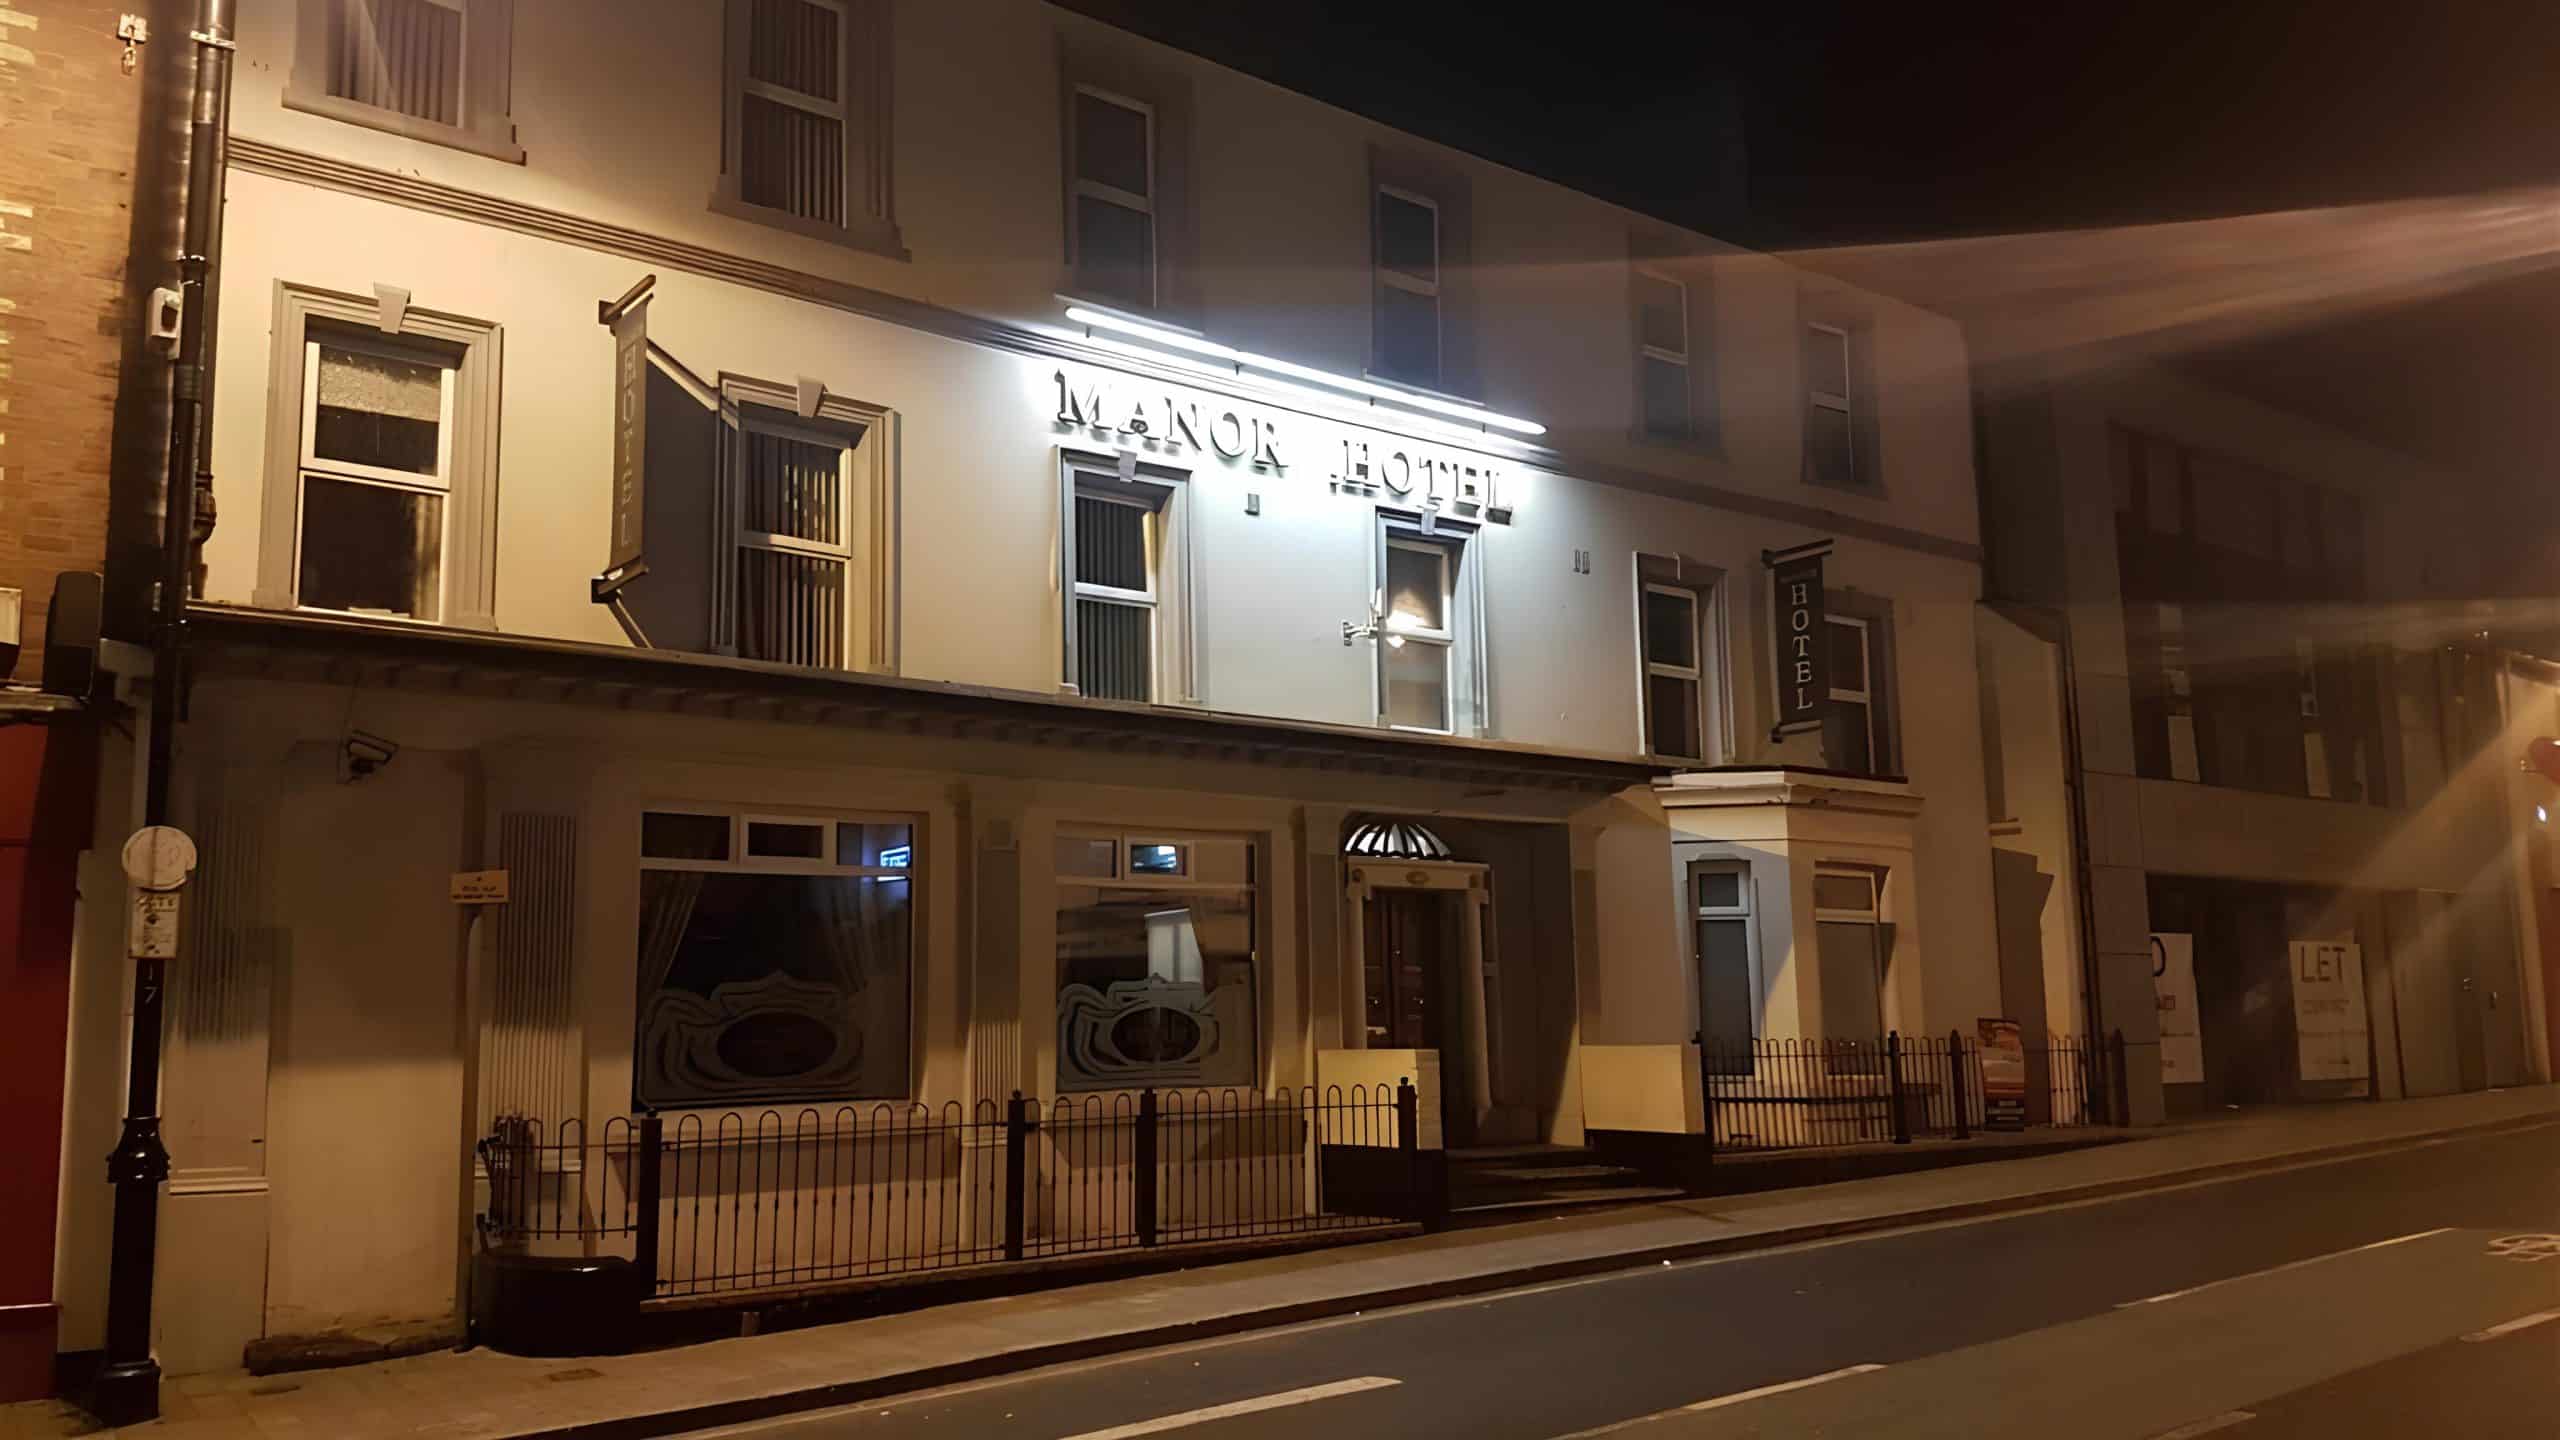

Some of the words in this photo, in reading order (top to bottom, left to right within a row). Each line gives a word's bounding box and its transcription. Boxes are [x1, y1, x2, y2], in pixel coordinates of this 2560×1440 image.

[1053, 369, 1289, 469] MANOR
[1330, 439, 1513, 525] HOTEL
[1791, 583, 1813, 710] HOTEL
[2301, 945, 2346, 983] LET
